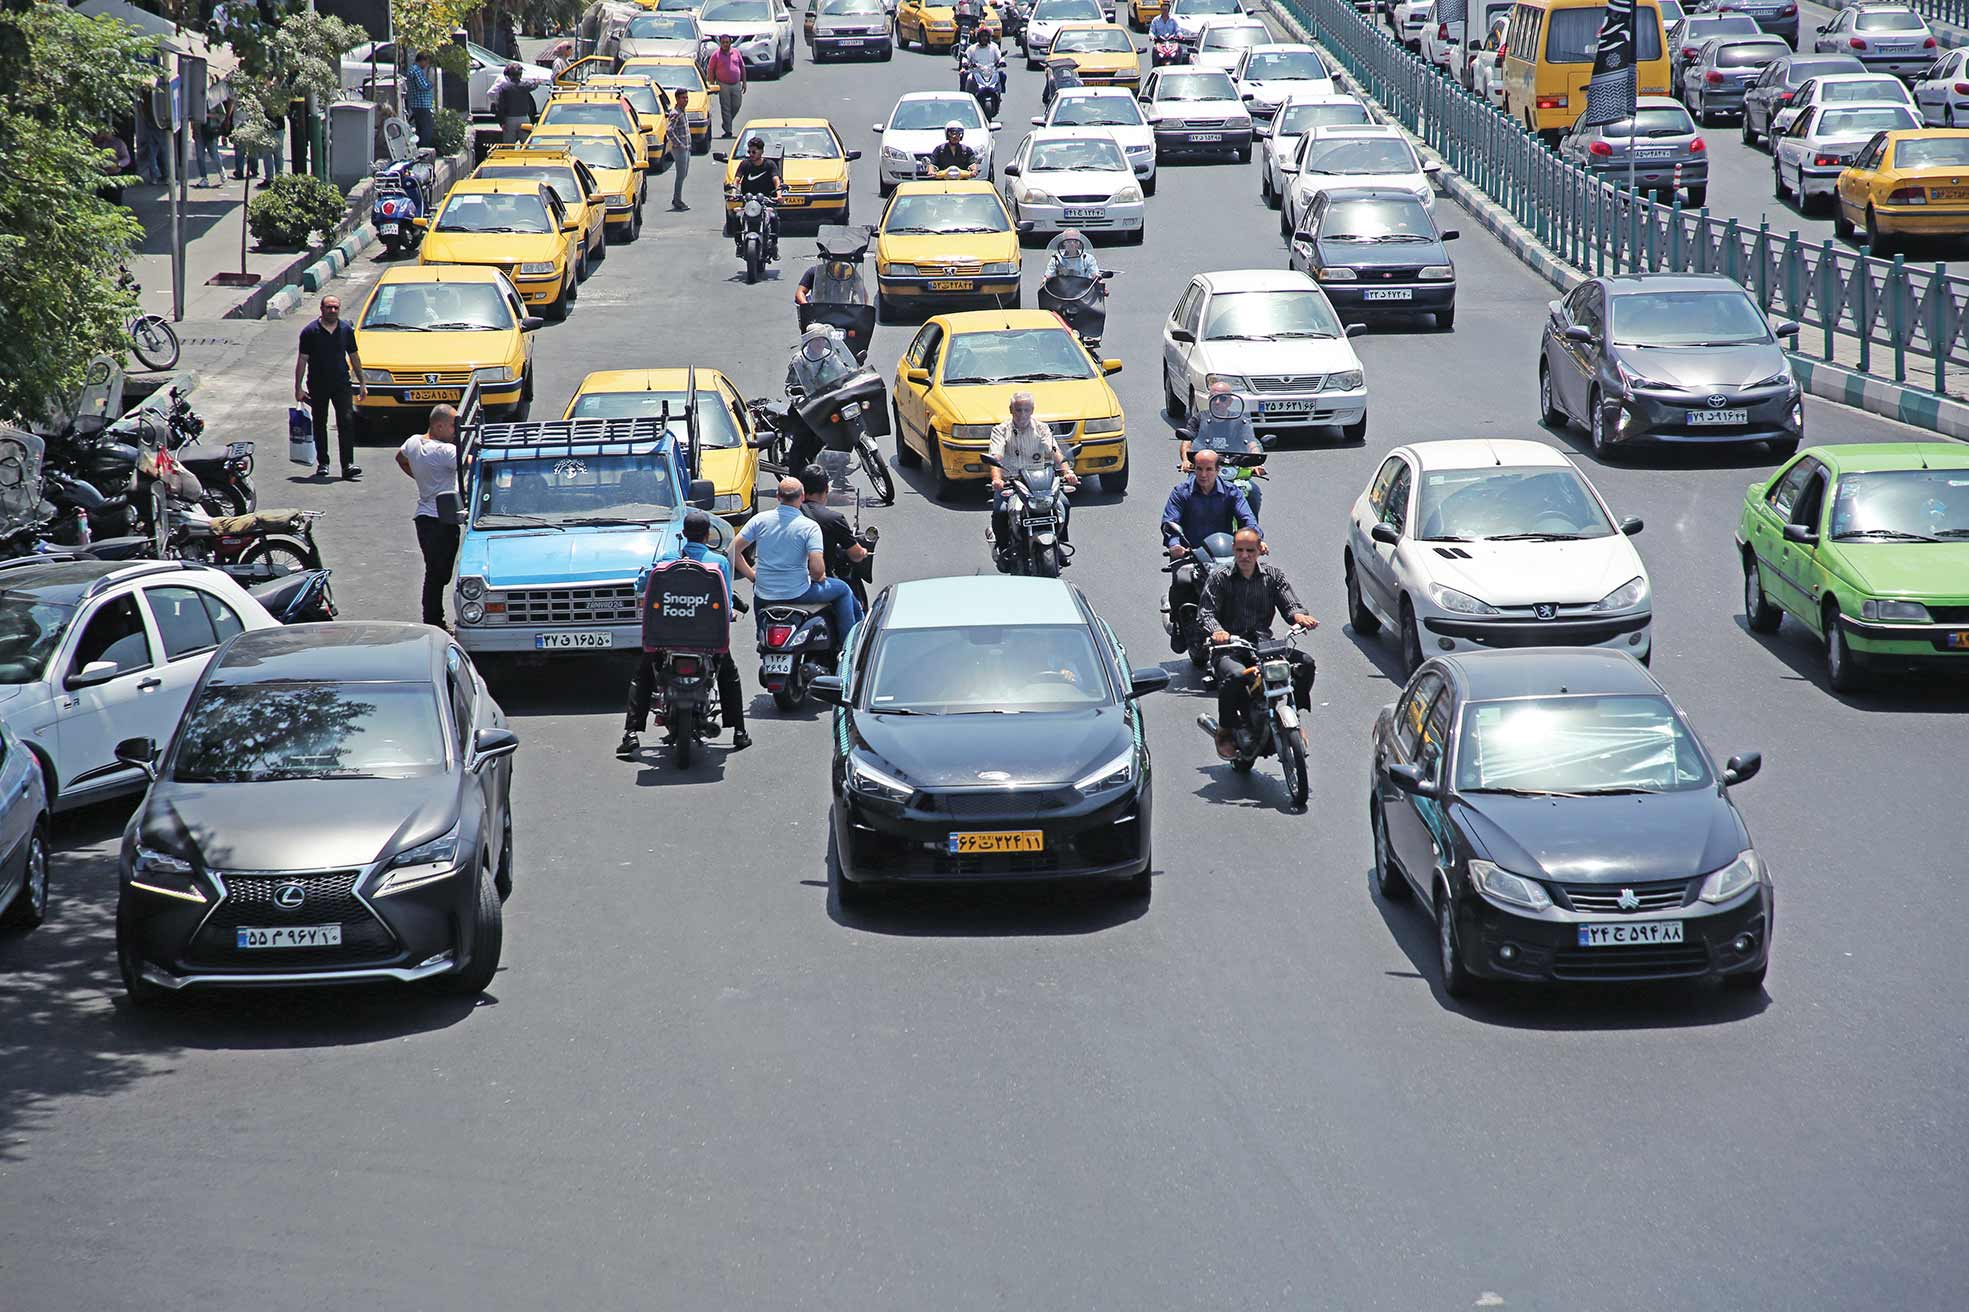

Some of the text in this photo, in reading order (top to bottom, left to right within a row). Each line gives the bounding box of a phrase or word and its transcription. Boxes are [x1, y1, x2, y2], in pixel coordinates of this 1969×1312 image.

[663, 592, 710, 607] Snapp!
[663, 605, 695, 617] Food
[543, 635, 558, 646] ۳۷
[574, 634, 595, 646] ۱۶۵
[959, 836, 977, 850] ۶۶
[995, 836, 1021, 850] ۳۲۴
[1026, 837, 1040, 849] ۱۱
[248, 932, 267, 945] ۵۵
[287, 929, 317, 944] ۹۶۷
[322, 931, 338, 943] ۱۰
[1590, 928, 1609, 943] ۲۴
[1630, 926, 1659, 941] ۵۹۴
[1662, 928, 1681, 940] ۸۸
